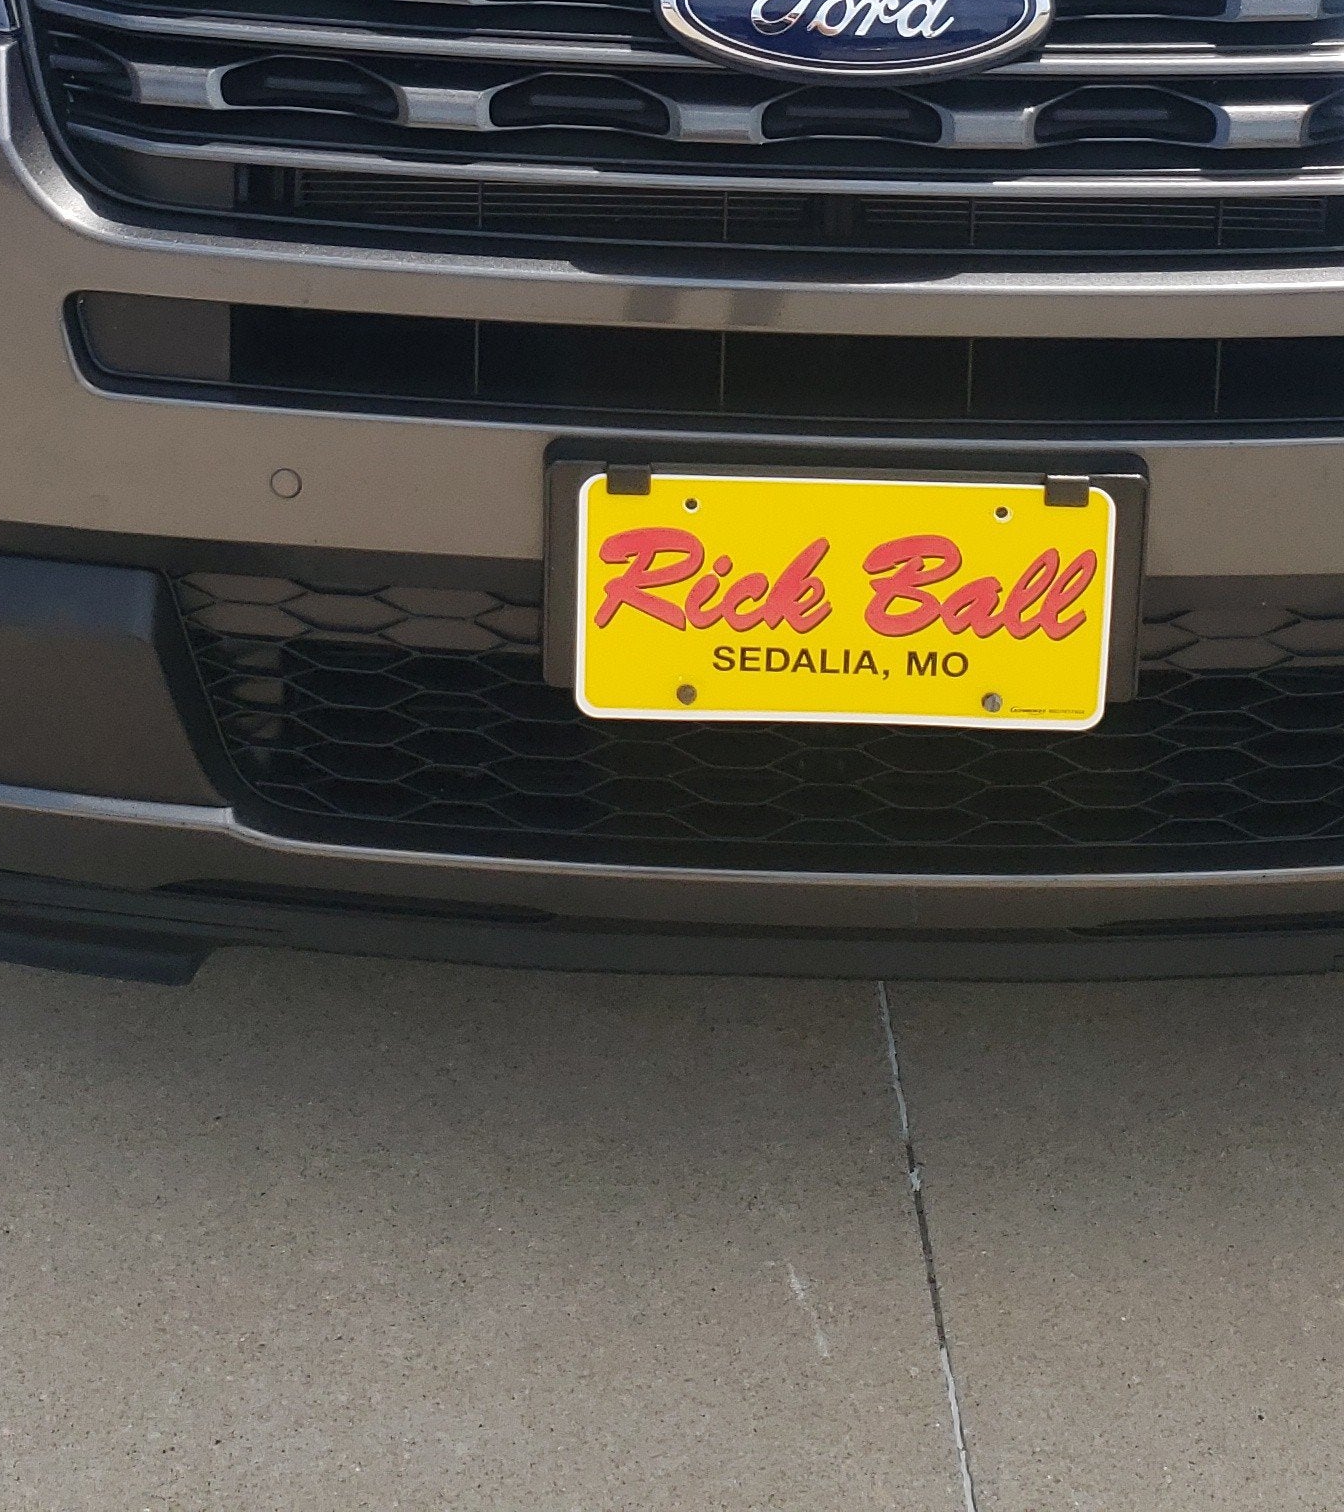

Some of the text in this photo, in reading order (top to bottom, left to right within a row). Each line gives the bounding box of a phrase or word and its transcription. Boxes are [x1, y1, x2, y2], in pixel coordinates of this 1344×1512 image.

[594, 526, 1098, 641] Rick Ball
[712, 644, 969, 681] SEDALIA, MO
